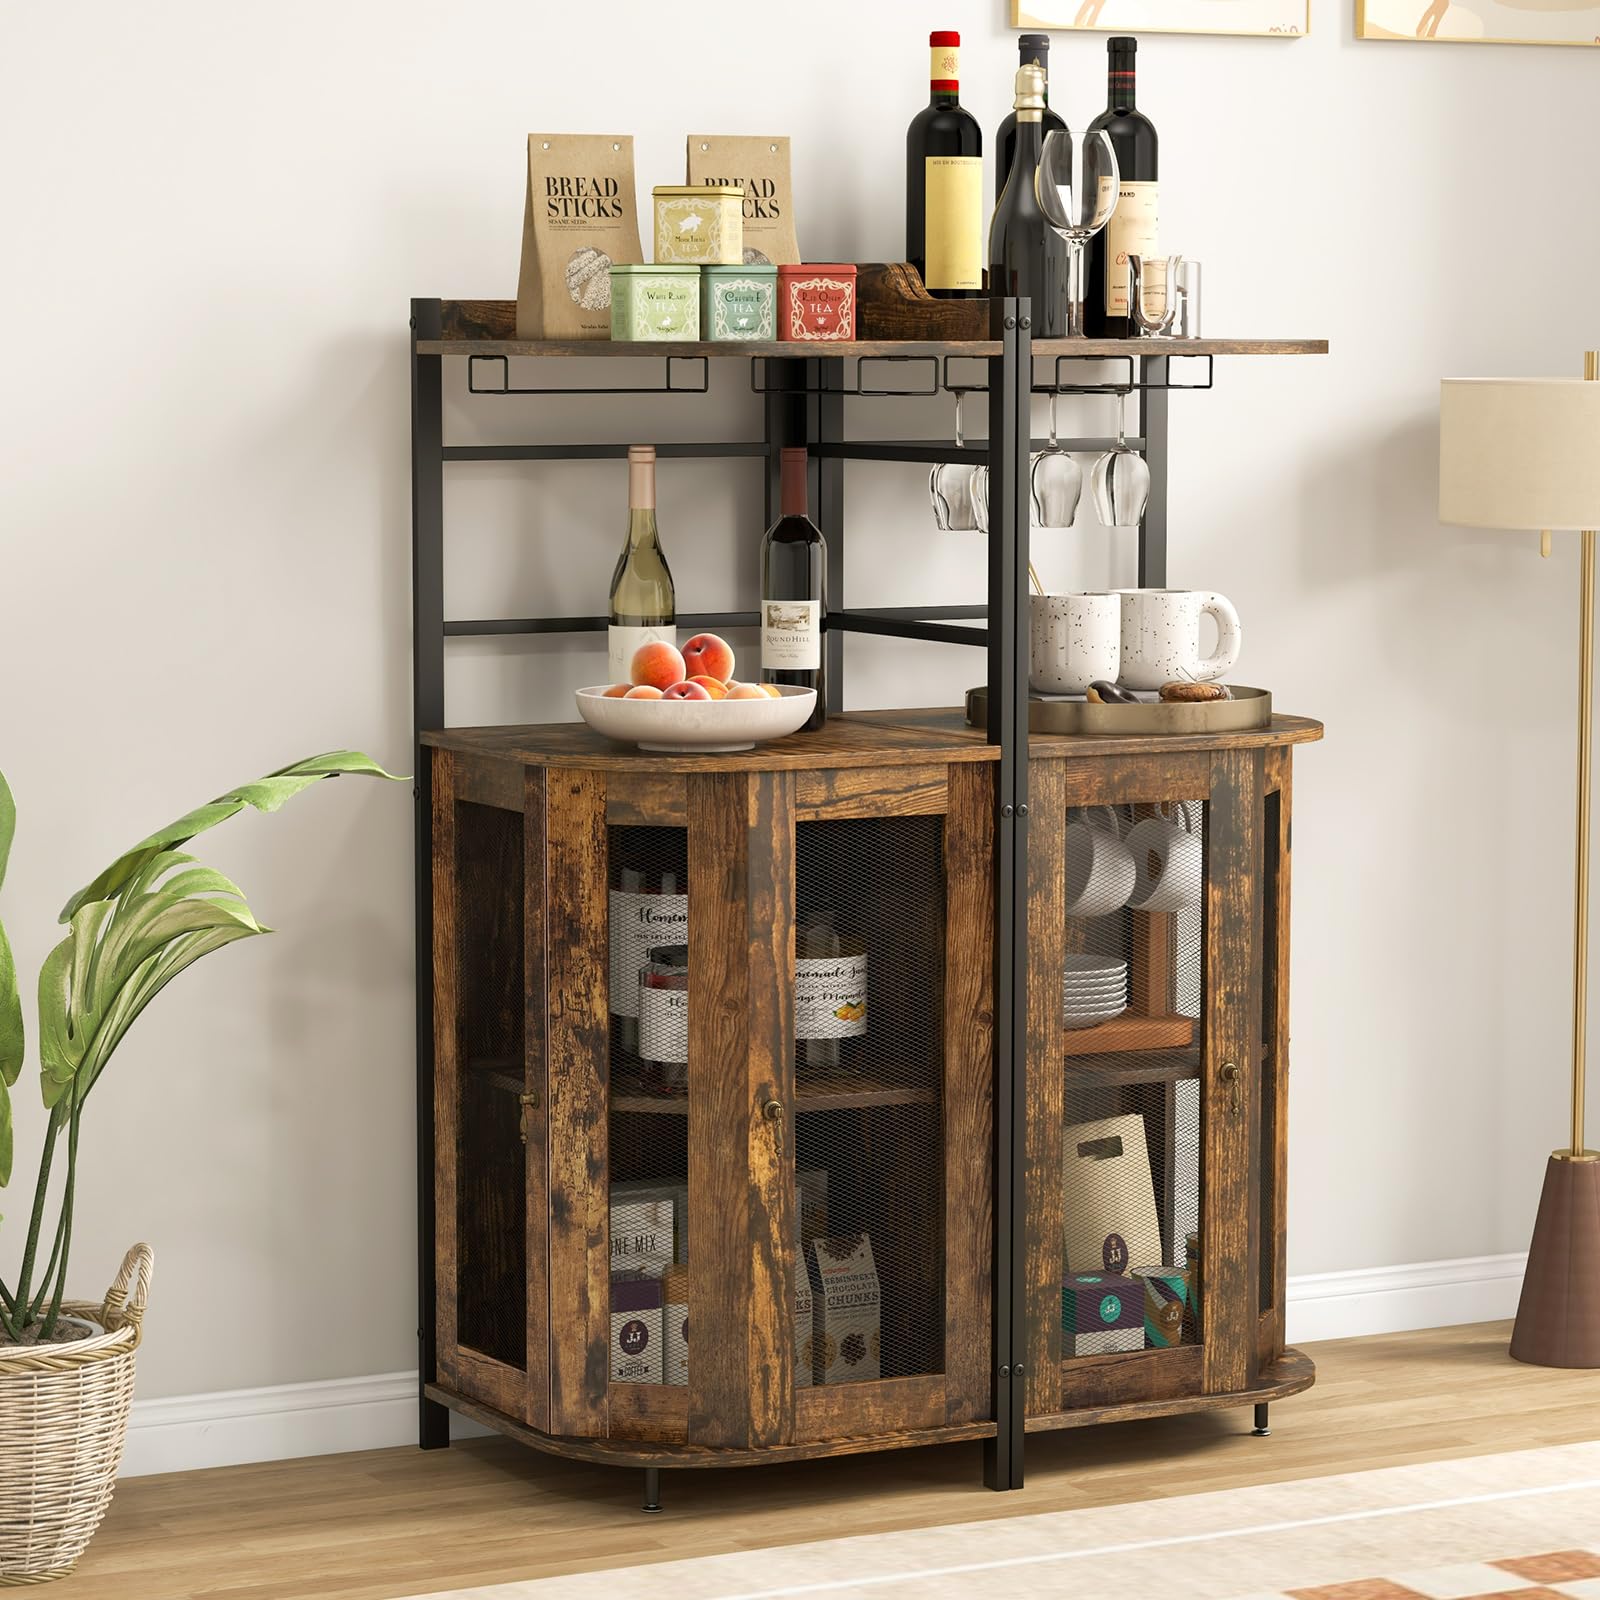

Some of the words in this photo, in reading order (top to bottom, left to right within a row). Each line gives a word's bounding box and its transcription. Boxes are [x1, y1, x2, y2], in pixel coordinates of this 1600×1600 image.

[544, 176, 618, 197] BREAD
[548, 198, 623, 218] STICKS
[742, 198, 780, 219] CKS
[733, 303, 754, 313] TEA
[810, 303, 833, 313] TEA
[635, 1234, 656, 1253] MIX
[825, 1273, 876, 1285] SEMISWEET
[826, 1281, 878, 1294] CHOCOLATE
[827, 1291, 879, 1306] CHUNKS
